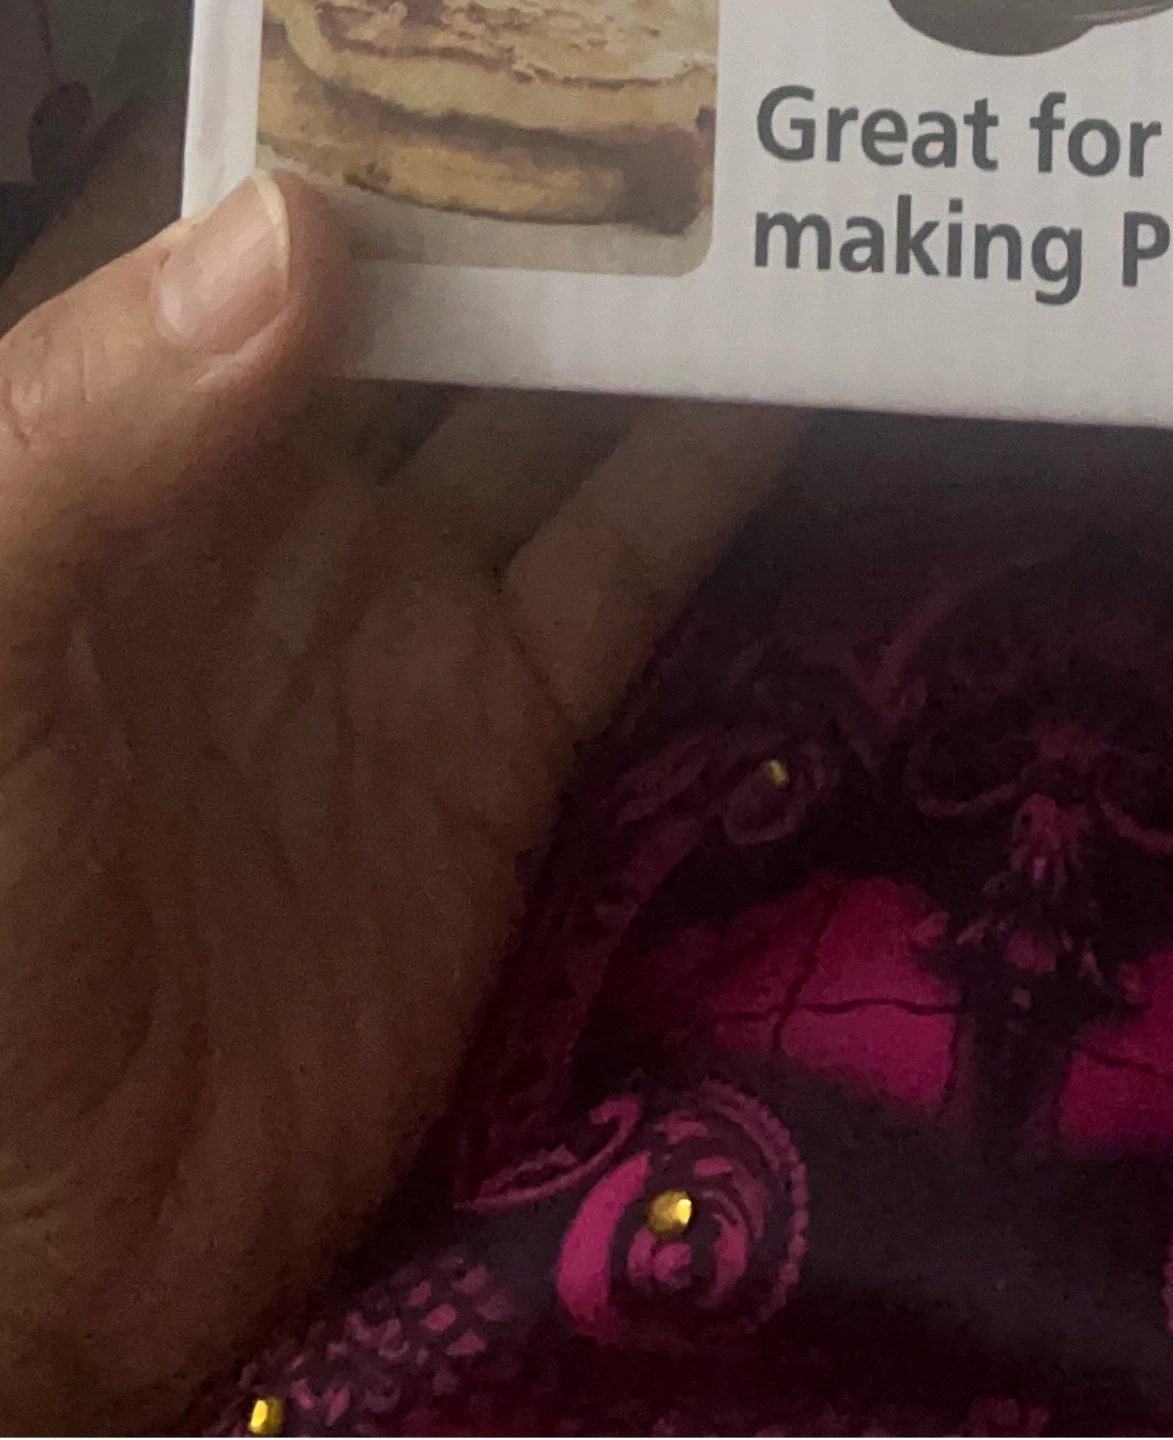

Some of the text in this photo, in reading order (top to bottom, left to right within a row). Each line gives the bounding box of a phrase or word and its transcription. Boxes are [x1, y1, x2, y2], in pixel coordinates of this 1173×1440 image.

[756, 85, 1162, 178] Great for
[754, 194, 1083, 306] making
